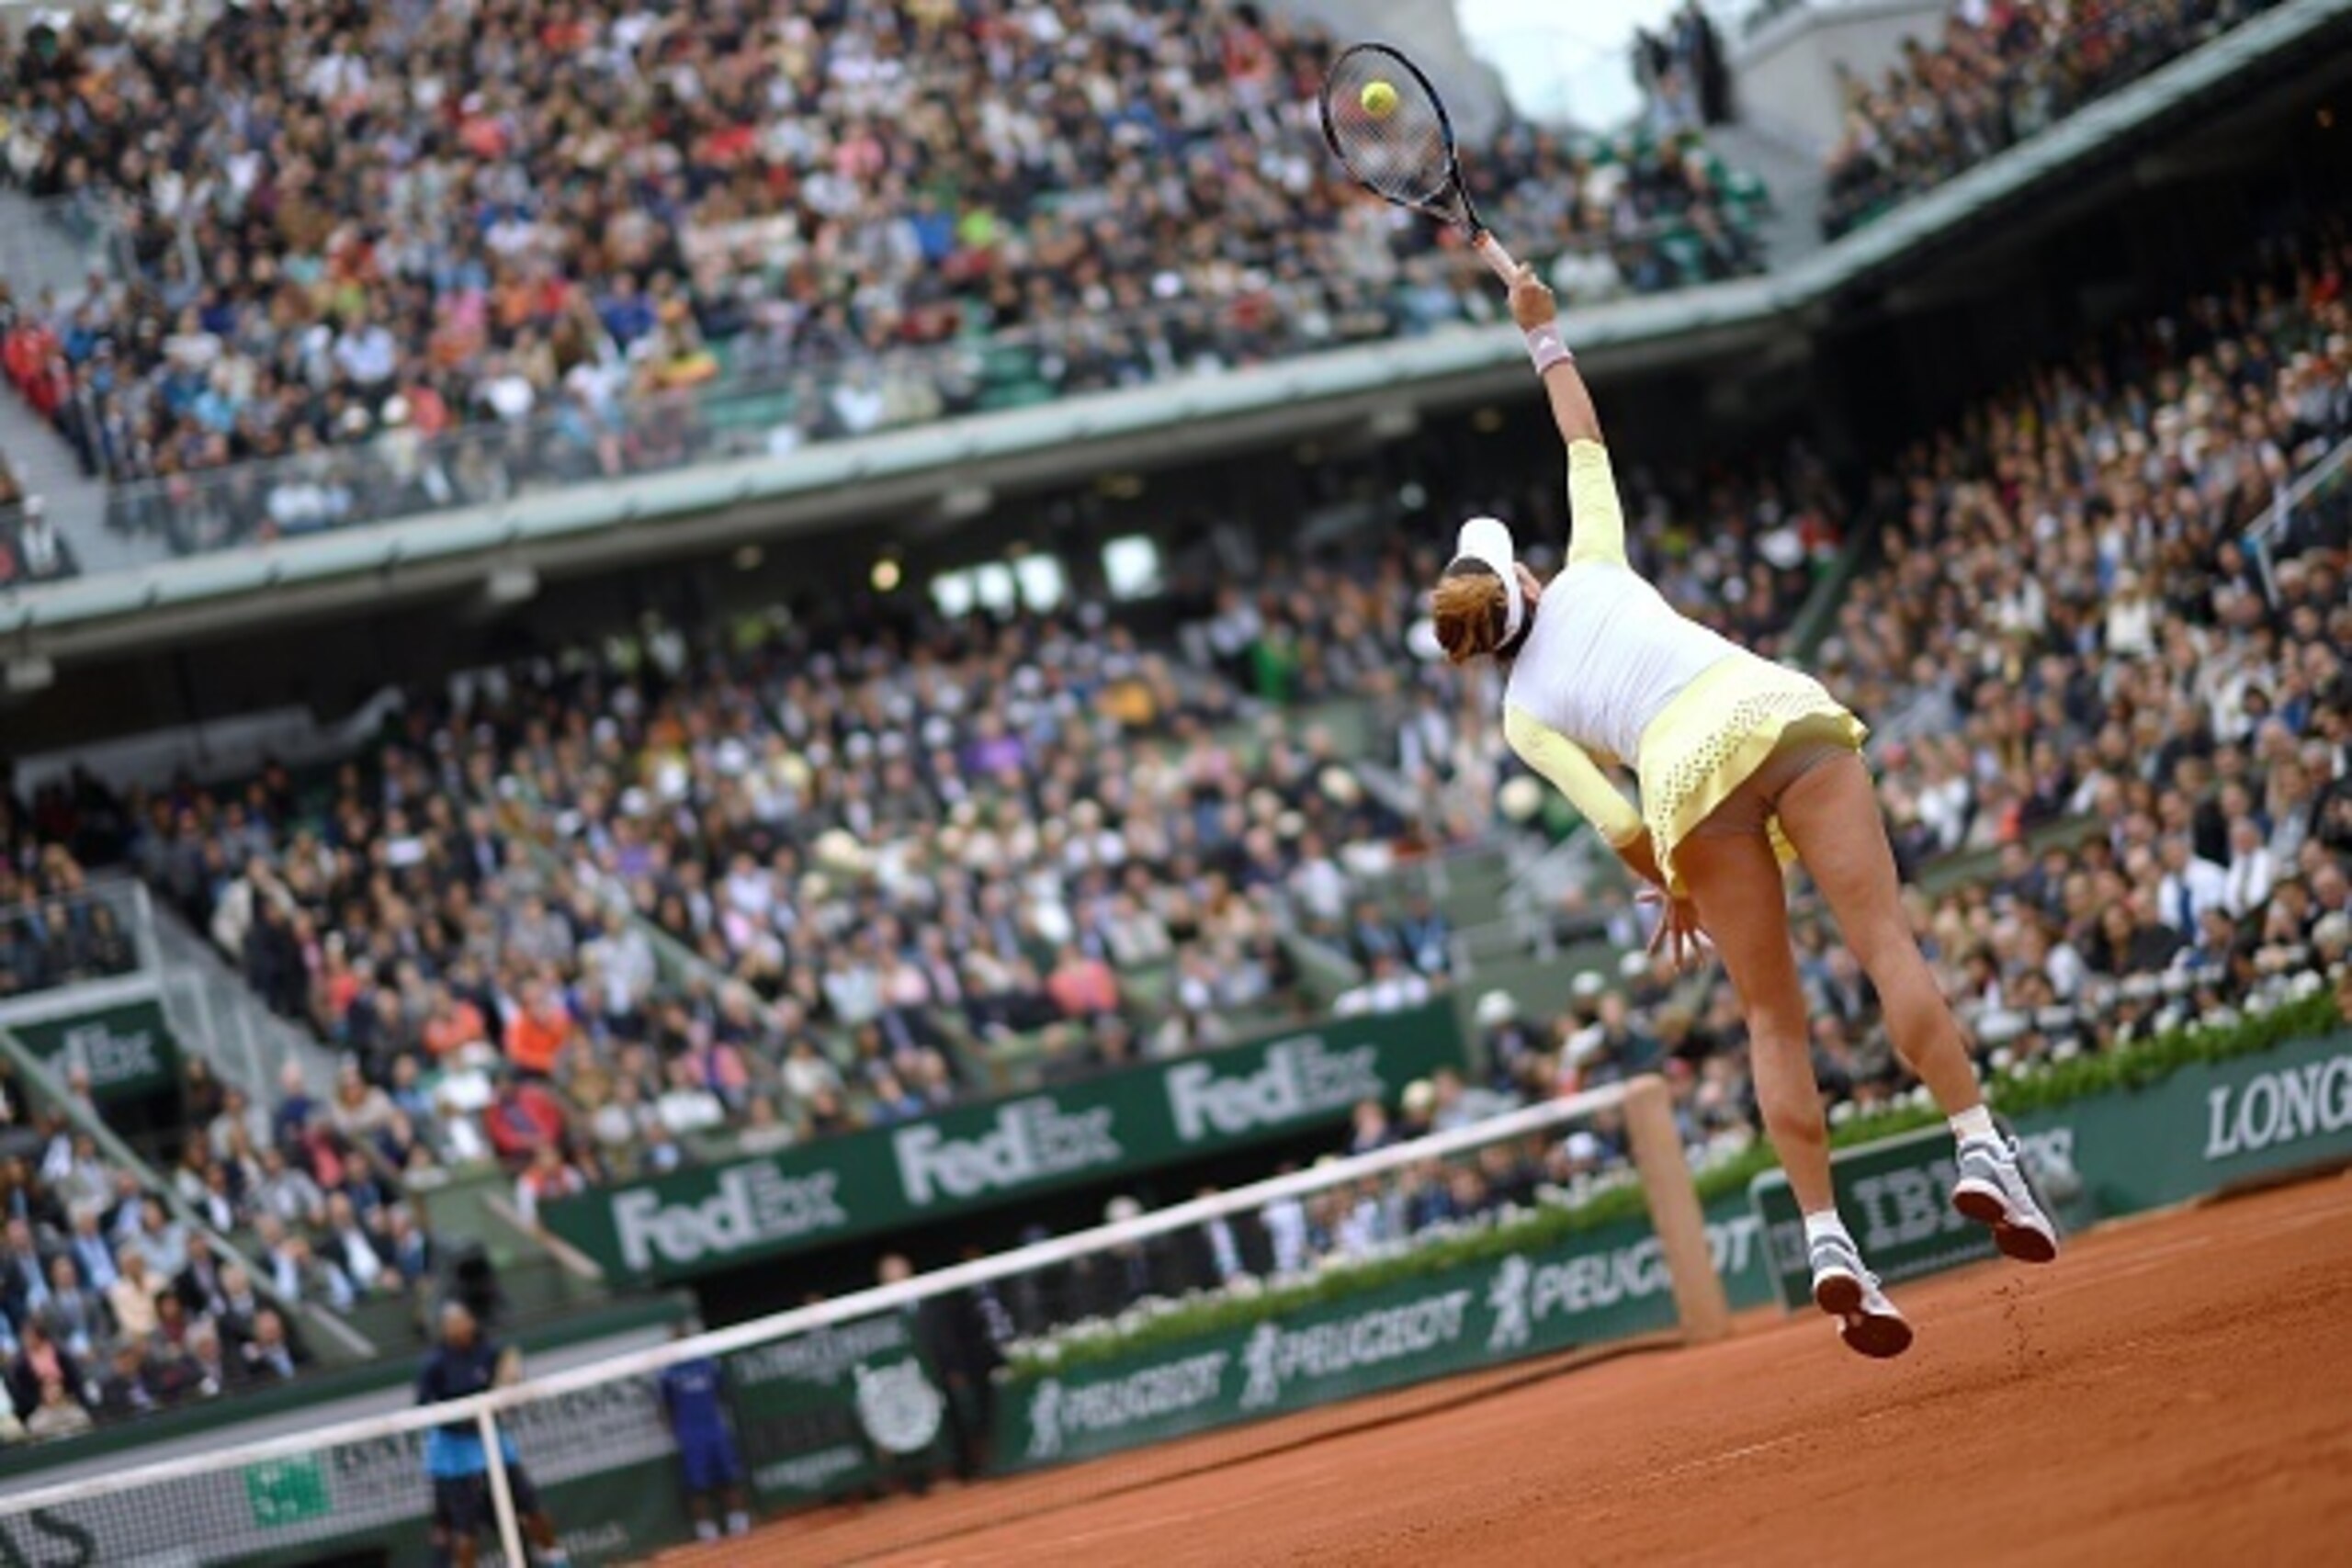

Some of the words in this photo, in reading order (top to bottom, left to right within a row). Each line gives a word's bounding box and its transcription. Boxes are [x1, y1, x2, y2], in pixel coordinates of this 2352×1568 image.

[1167, 1037, 1385, 1140] FedEx
[894, 1098, 1122, 1202] FedEx
[614, 1162, 846, 1269] FedEx
[1278, 1291, 1472, 1374] PEUGEOT
